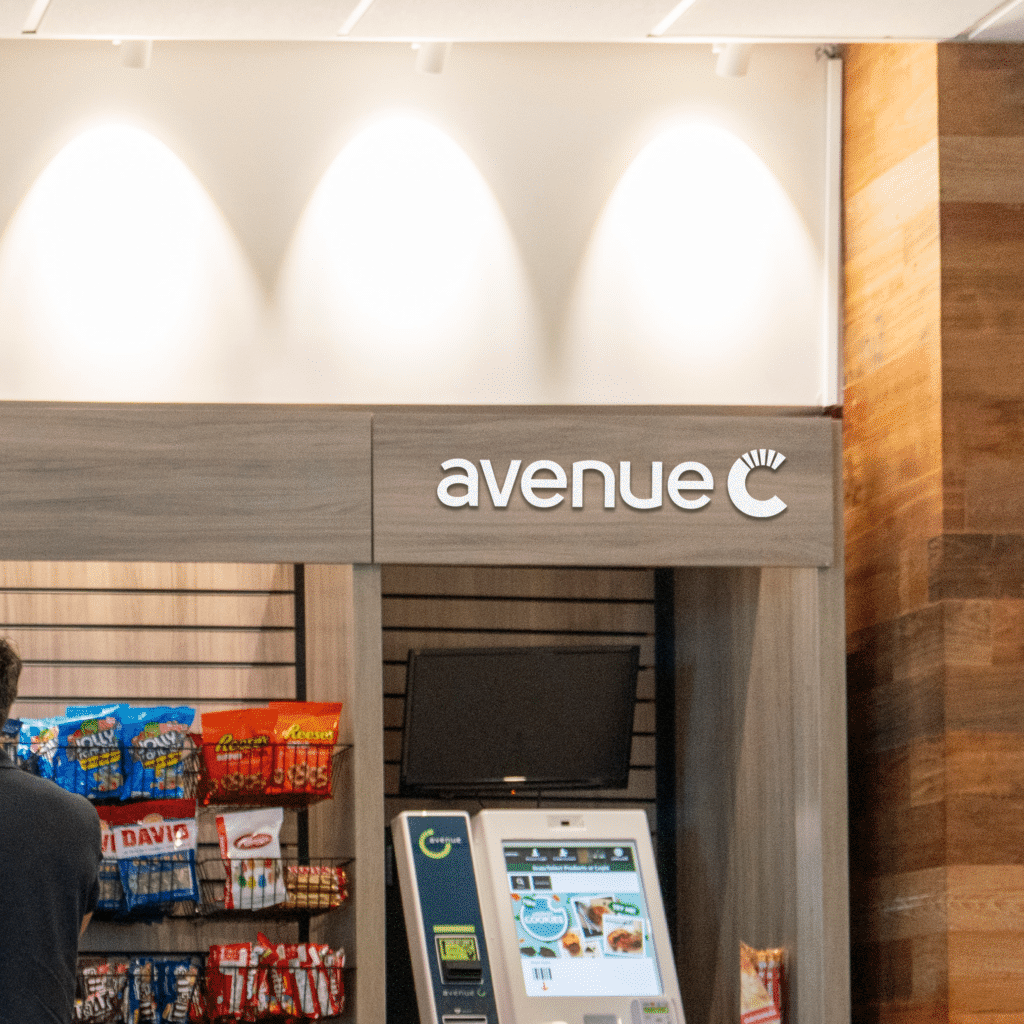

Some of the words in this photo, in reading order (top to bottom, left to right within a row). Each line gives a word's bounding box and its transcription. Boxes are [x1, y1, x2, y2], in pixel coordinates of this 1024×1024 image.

[437, 458, 714, 509] avenue
[727, 448, 788, 518] C
[121, 823, 189, 848] DAVID
